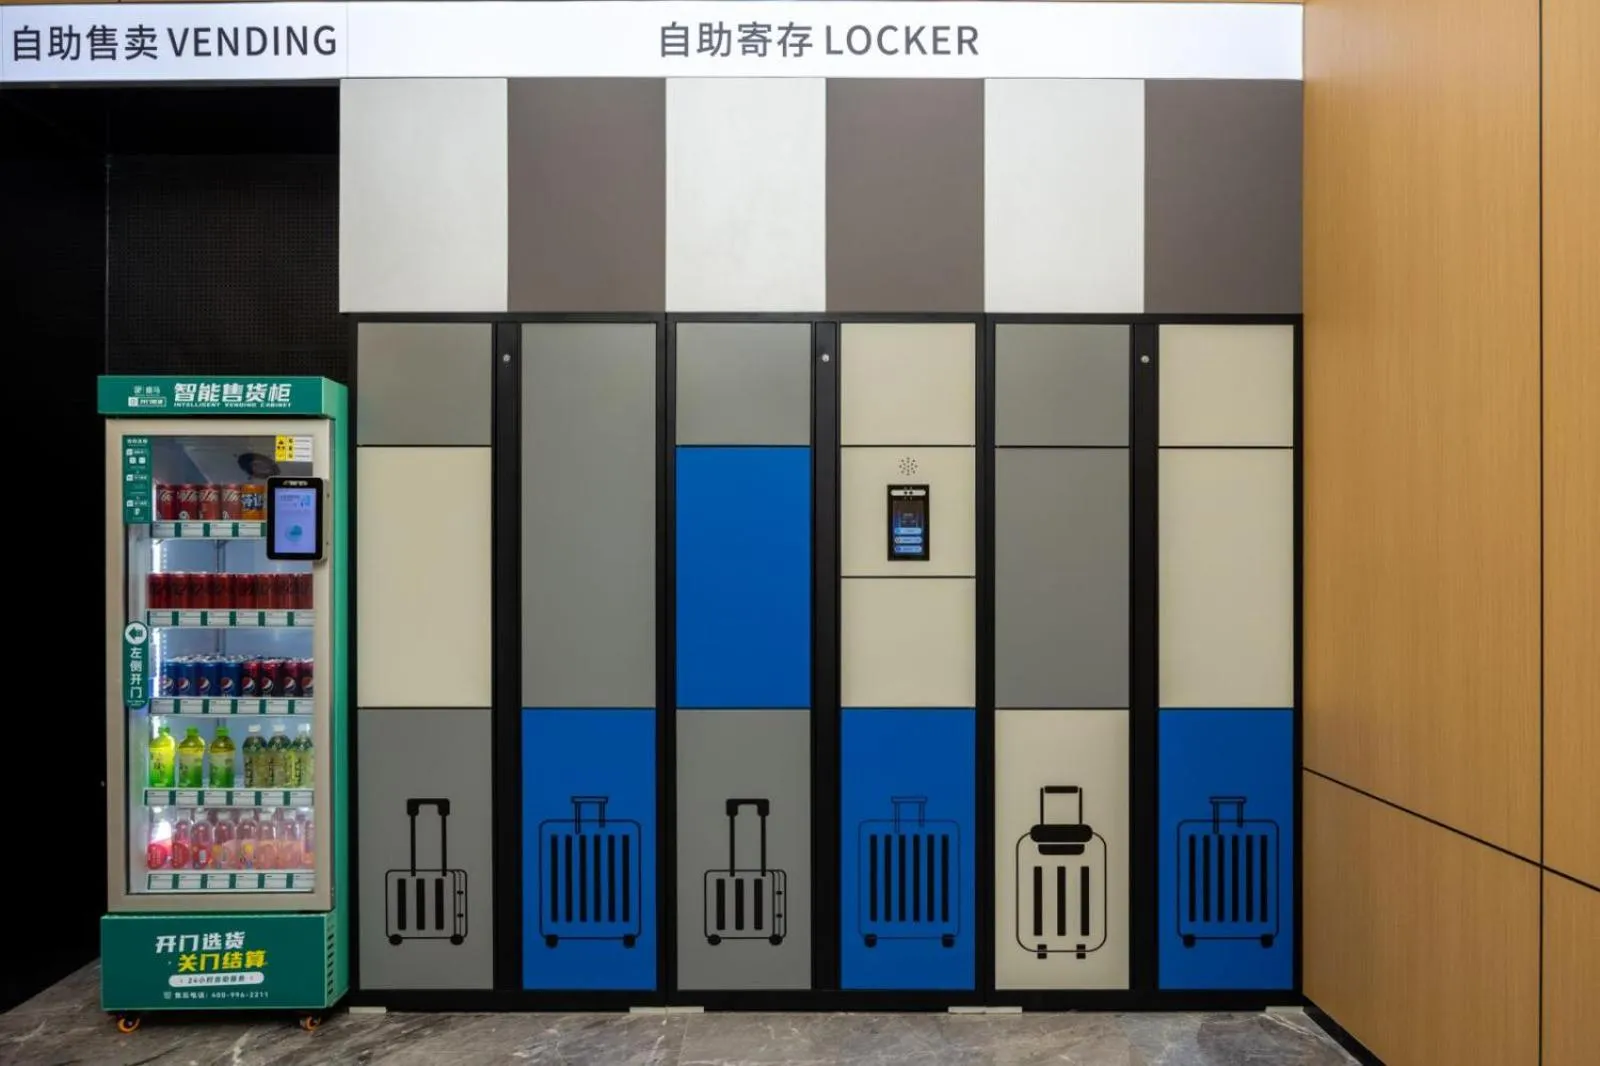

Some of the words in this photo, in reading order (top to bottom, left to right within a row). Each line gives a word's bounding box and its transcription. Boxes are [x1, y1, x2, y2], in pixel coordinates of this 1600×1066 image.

[13, 24, 158, 61] 自助售卖
[167, 25, 337, 57] VENDING
[660, 21, 813, 58] 自助寄存
[825, 24, 979, 56] LOCKER
[174, 383, 292, 402] 智能售货柜
[129, 647, 143, 699] 左侧开门
[155, 931, 246, 953] 开门选货
[178, 950, 266, 972] 关门结算
